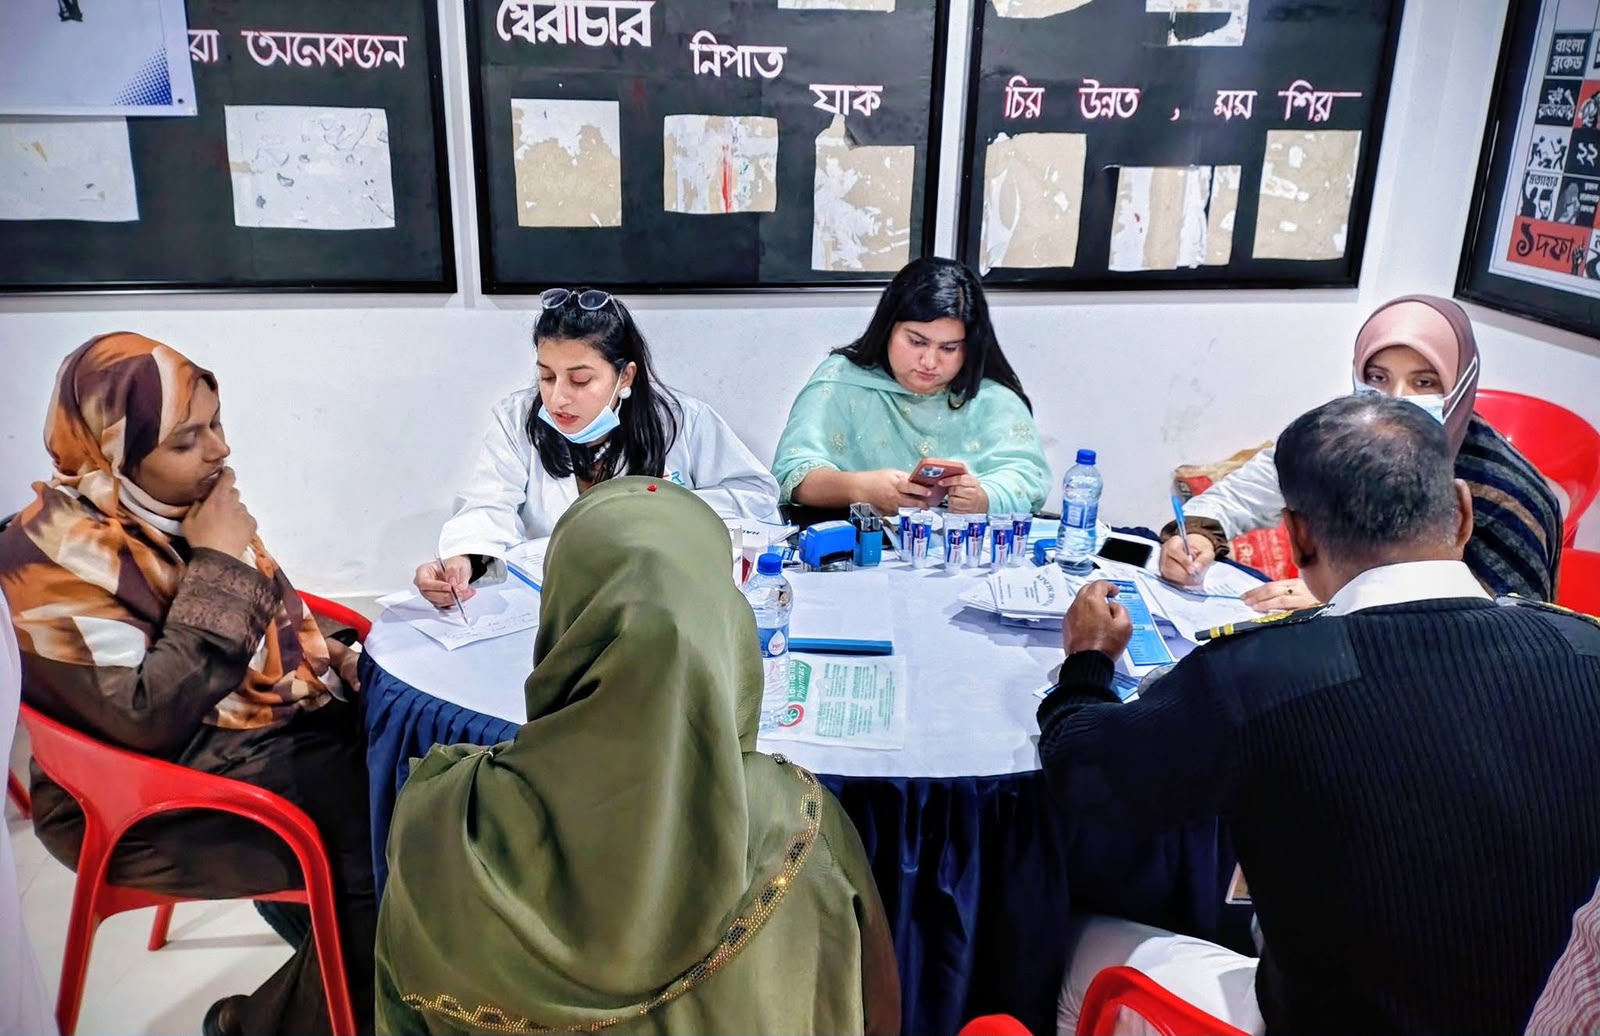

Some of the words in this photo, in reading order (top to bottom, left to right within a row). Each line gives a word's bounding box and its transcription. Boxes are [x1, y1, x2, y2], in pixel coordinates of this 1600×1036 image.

[188, 29, 220, 62] রা
[241, 30, 408, 69] অনেকজন
[1556, 39, 1585, 53] বাংলা
[690, 30, 787, 78] নিপাত
[809, 84, 883, 116] যাক
[1005, 75, 1045, 119] চির
[1078, 78, 1140, 119] উন্নত
[1214, 90, 1257, 121] মম
[1278, 80, 1362, 122] শির
[1516, 222, 1534, 257] ১
[1536, 233, 1574, 263] দফা
[797, 662, 808, 699] Pharmacy
